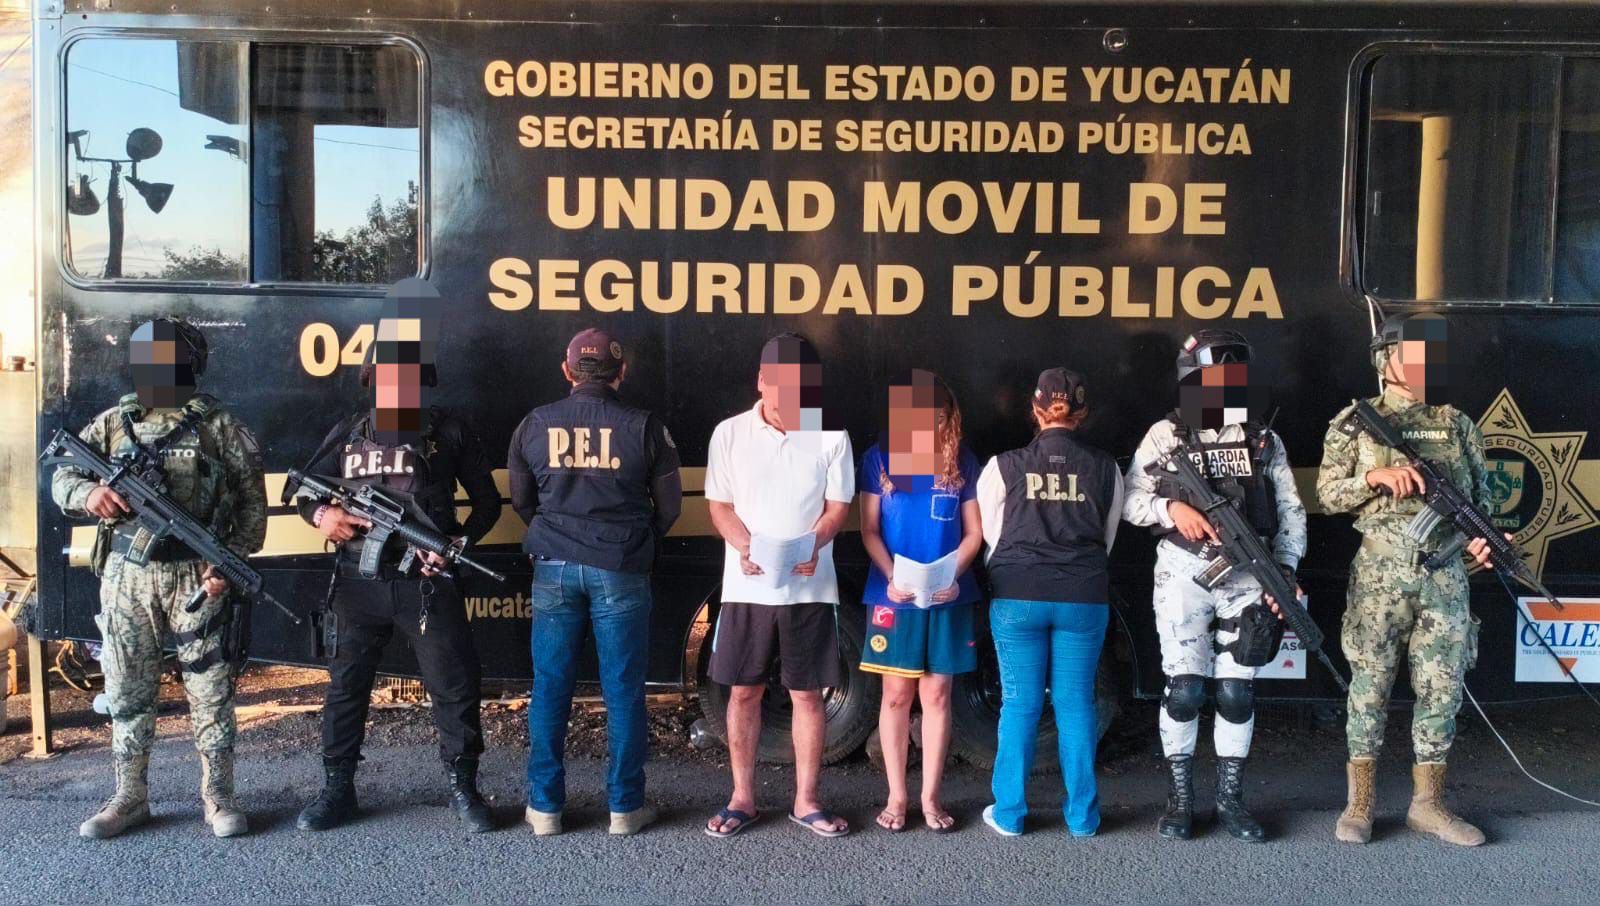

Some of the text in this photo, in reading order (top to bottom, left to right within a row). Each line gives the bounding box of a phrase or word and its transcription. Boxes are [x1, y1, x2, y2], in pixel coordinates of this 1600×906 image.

[484, 59, 1290, 103] GOBIERNO DEL ESTADO DE YUCATÁN
[518, 110, 1252, 155] SECRETARÍA DE SEGURIDAD PÚBLICA
[547, 177, 1227, 236] UNIDAD MOVIL DE
[488, 250, 1284, 319] SEGURIDAD PÚBLICA
[300, 322, 377, 377] 04
[547, 427, 621, 470] P.E.I.
[1402, 430, 1449, 440] MARINA
[344, 450, 414, 479] P.E.I.
[1192, 450, 1246, 466] GARDIA
[1196, 462, 1250, 477] ACIONAL
[1025, 472, 1086, 502] P.E.I.
[1484, 438, 1553, 543] SEGURIDAD PUBLIC
[464, 592, 534, 622] yucata
[1520, 621, 1600, 648] CALE
